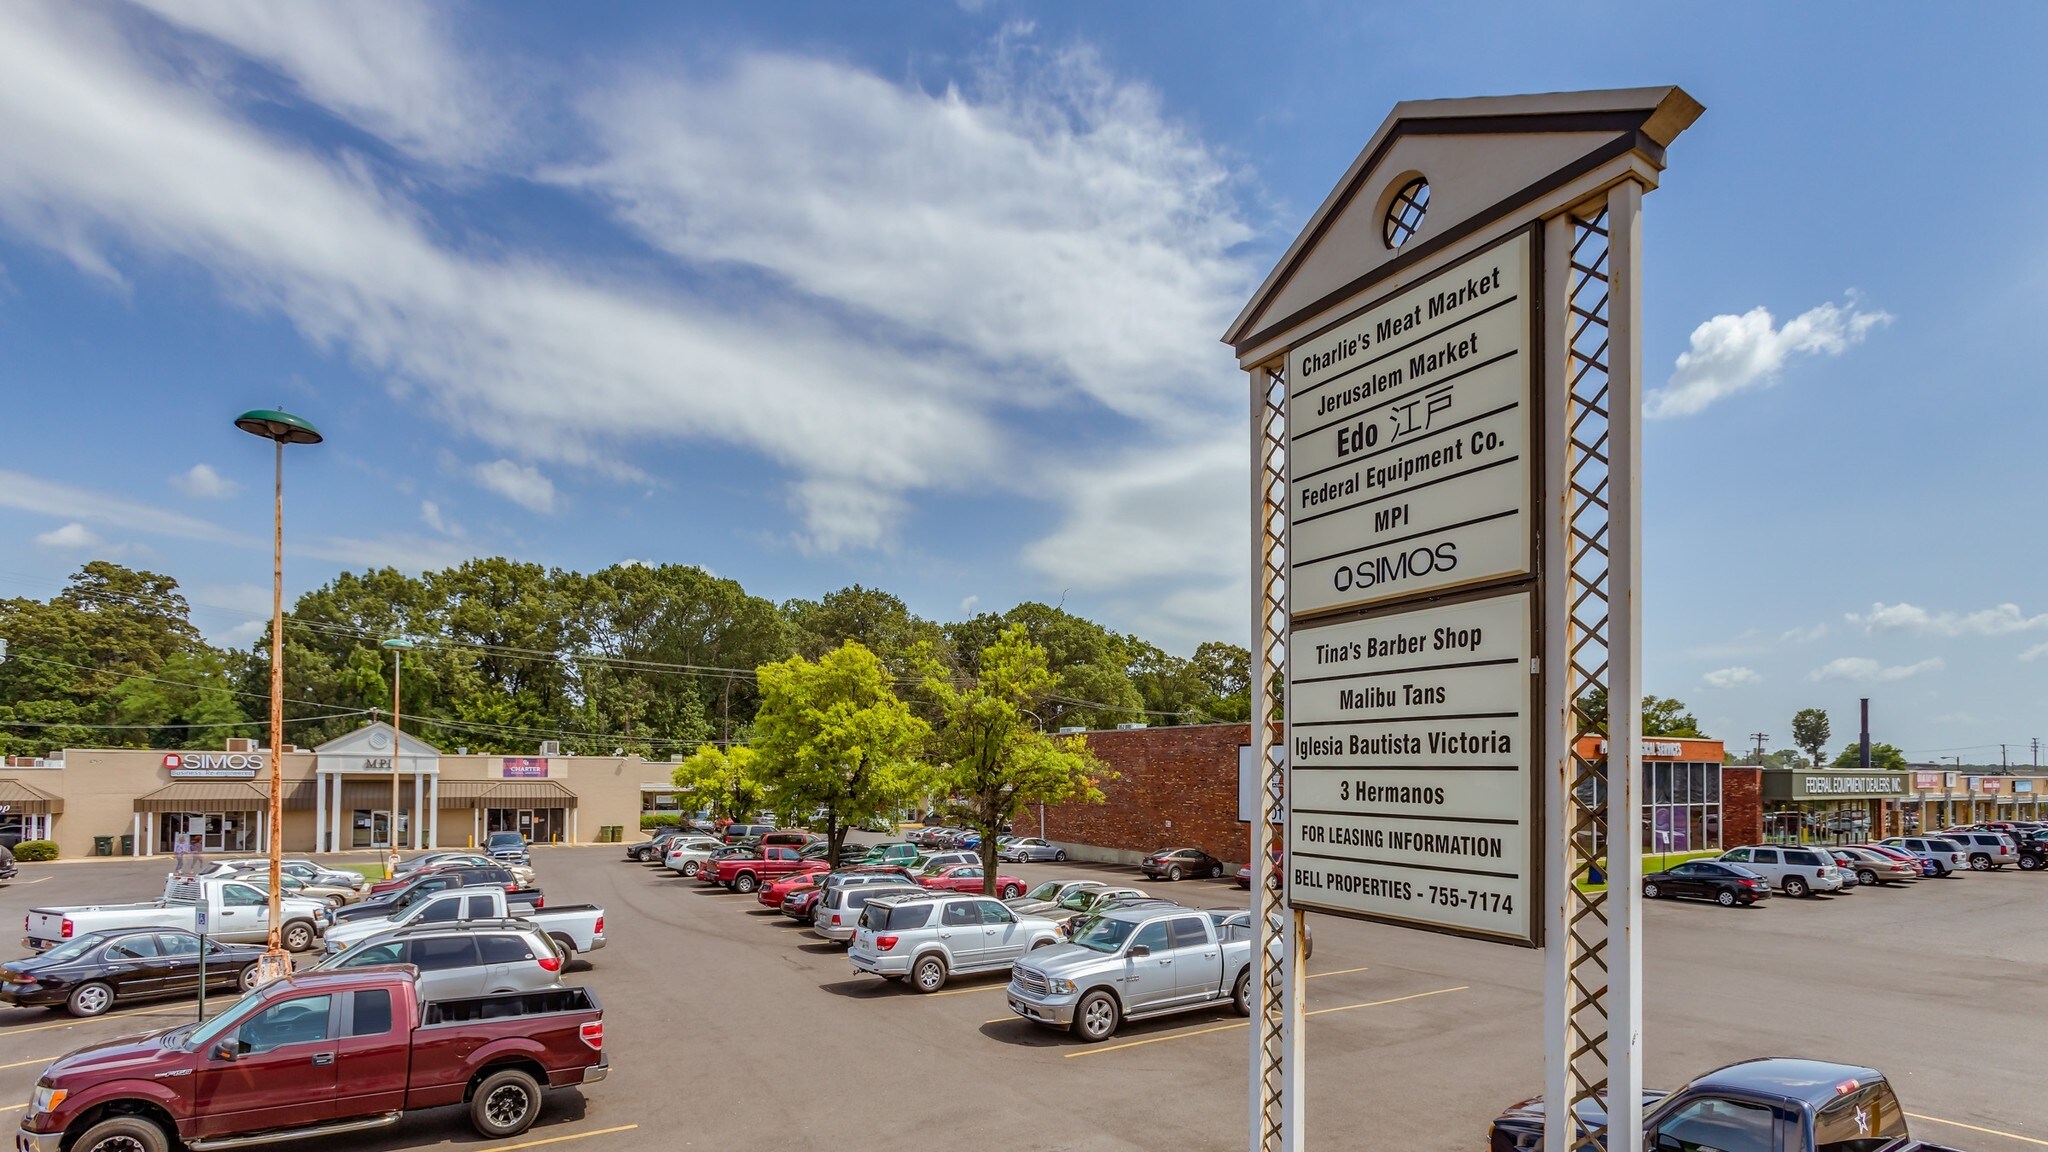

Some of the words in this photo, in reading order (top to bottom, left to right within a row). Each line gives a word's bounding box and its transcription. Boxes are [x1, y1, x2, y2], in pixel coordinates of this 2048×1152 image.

[1302, 333, 1371, 378] Charlie's
[1376, 304, 1422, 344] Meat
[1428, 266, 1500, 320] Market
[1317, 368, 1403, 417] Jerusalem
[1409, 332, 1478, 380] Market
[1337, 421, 1378, 458] Edo
[1301, 471, 1360, 509] Federal
[1366, 438, 1463, 489] Equipment
[1470, 430, 1505, 456] Co.
[1374, 503, 1409, 533] MPI
[1355, 541, 1458, 589] SIMOS
[1315, 641, 1362, 665] Tina's
[1367, 633, 1427, 659] Barber
[1433, 626, 1482, 652] Shop
[1339, 686, 1396, 710] Malibu
[1402, 683, 1446, 706] Tans
[183, 754, 264, 770] SIMOS
[1295, 735, 1343, 761] Iglesia
[1349, 733, 1421, 755] Bautista
[1427, 729, 1511, 755] Victoria
[365, 758, 392, 769] MPI
[1340, 780, 1350, 801] 3
[1355, 780, 1445, 805] Hermanos
[1805, 776, 1833, 793] FEDERAL
[1833, 776, 1866, 793] EQUIPMENT
[1301, 824, 1325, 843] FOR
[1328, 826, 1384, 848] LEASING
[1388, 831, 1502, 858] INFORMATION
[1294, 868, 1323, 889] BELL
[1326, 872, 1412, 901] PROPERTIES
[1428, 885, 1514, 915] 755-7174
